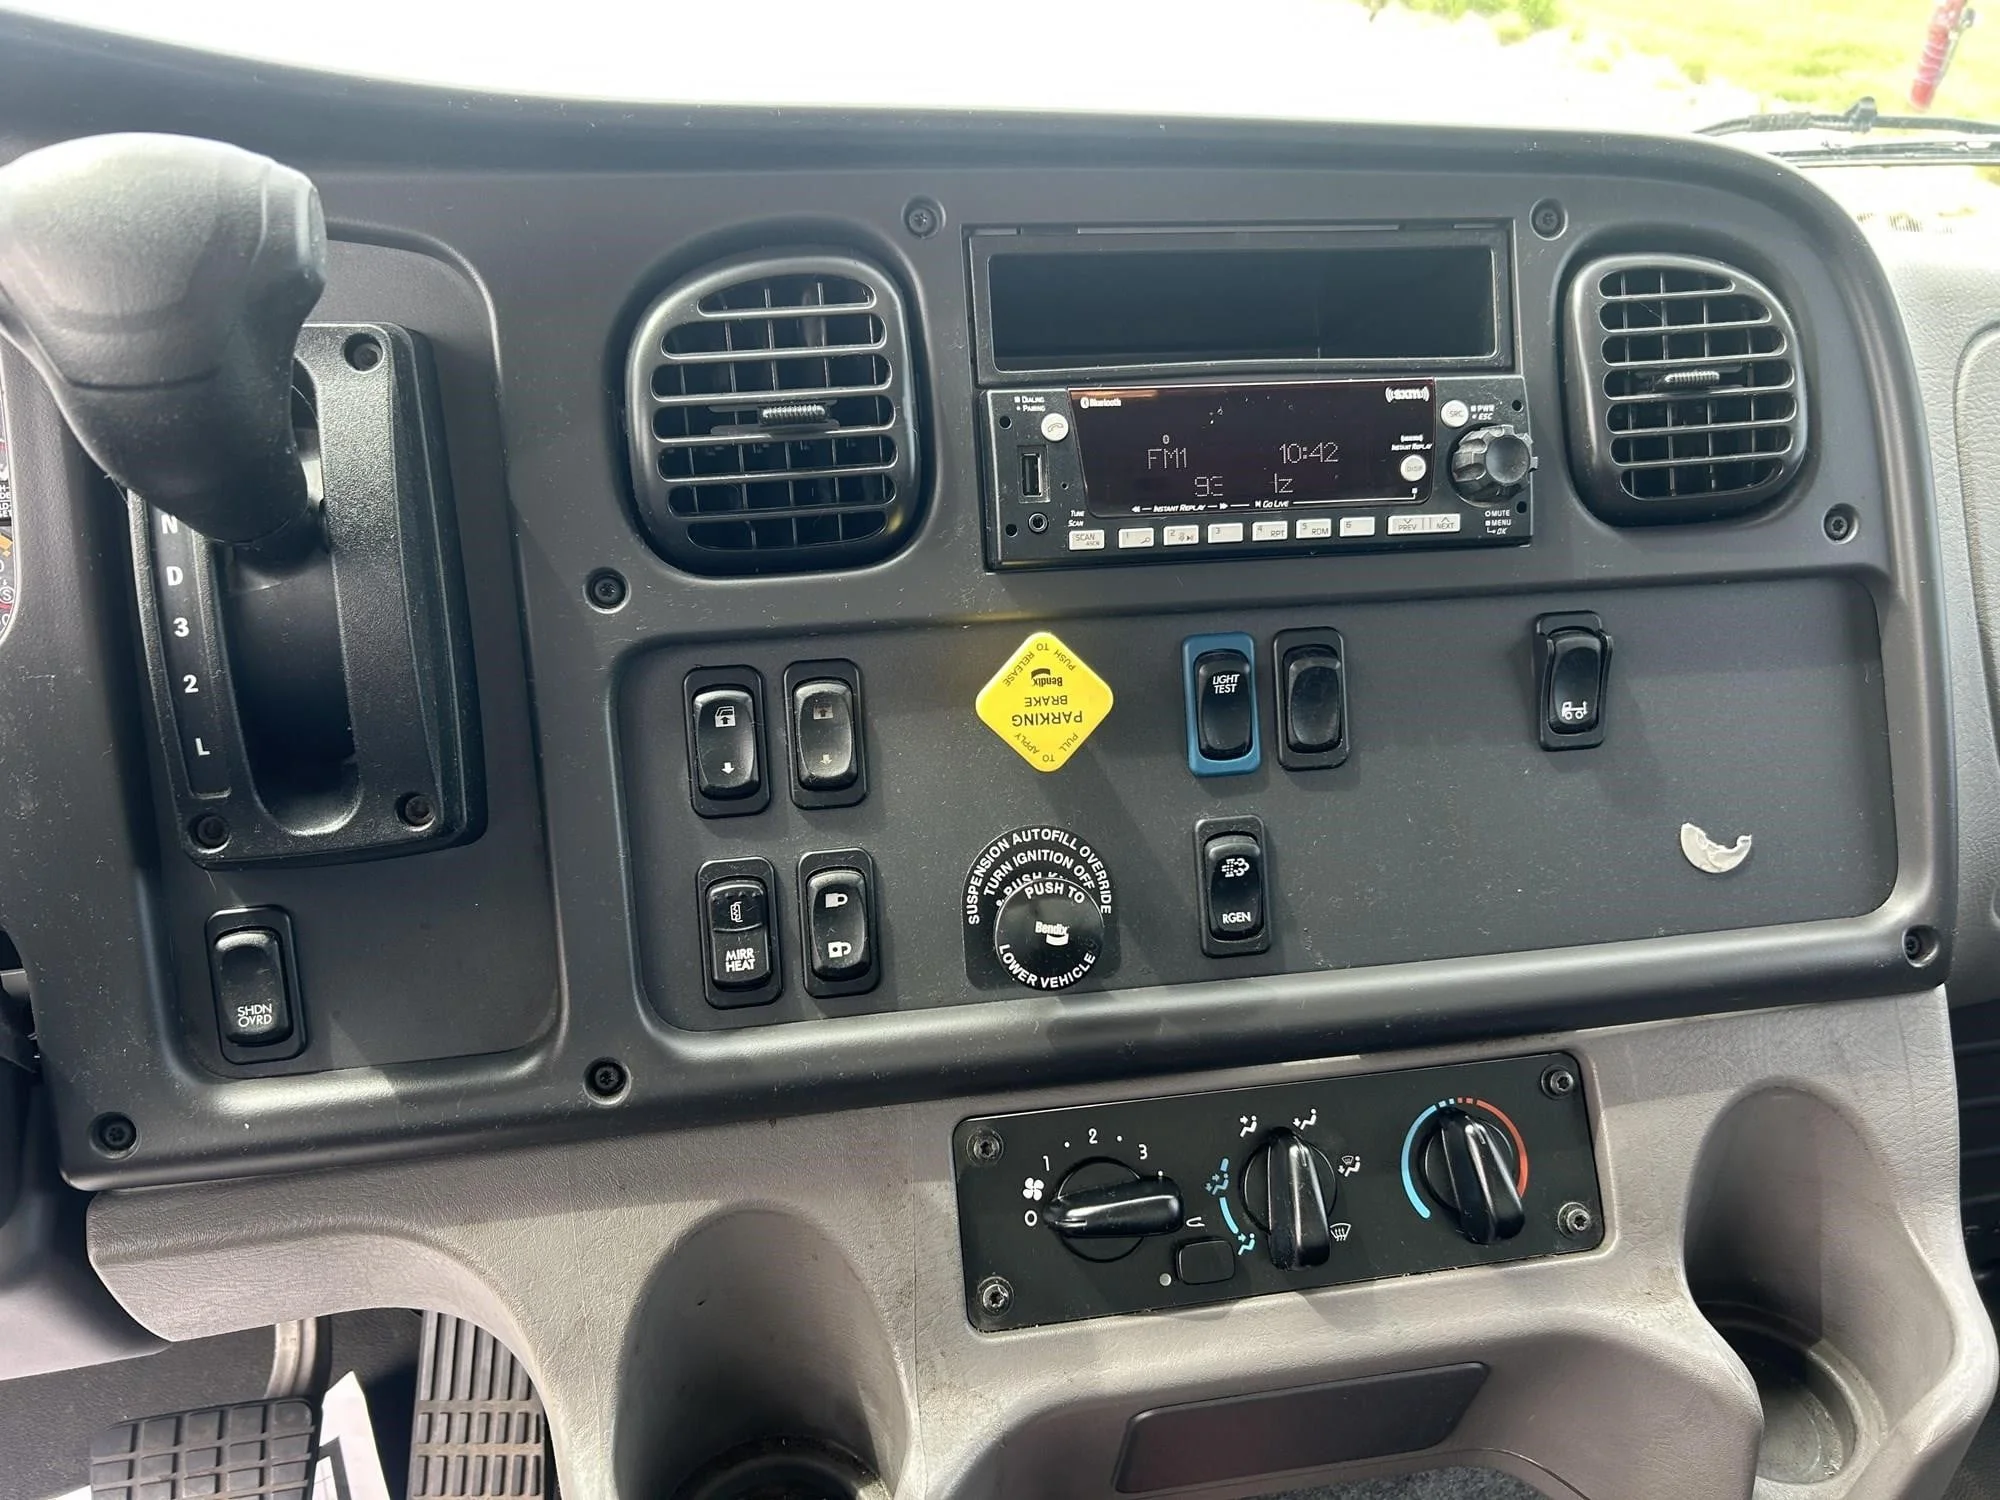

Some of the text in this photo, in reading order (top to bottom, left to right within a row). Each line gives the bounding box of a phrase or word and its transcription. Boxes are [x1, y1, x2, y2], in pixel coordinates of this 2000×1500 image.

[1448, 410, 1464, 418] SRC
[1477, 404, 1494, 412] PWR
[1478, 412, 1494, 420] ESC
[1147, 447, 1187, 469] FM1
[1279, 442, 1339, 464] 10:42
[161, 514, 178, 534] N
[1496, 527, 1508, 535] OK
[1075, 533, 1096, 541] SCAN
[166, 566, 184, 586] D
[173, 617, 190, 637] 3
[1002, 642, 1077, 687] PUSH TO RELEASE
[183, 674, 198, 694] 2
[1033, 676, 1063, 687] Bendix
[1212, 674, 1240, 685] LIGHT
[1214, 683, 1237, 694] TEST
[1024, 695, 1068, 707] BRAKE
[1012, 710, 1083, 727] PARKING
[195, 738, 210, 756] L
[1014, 732, 1079, 762] PULL TO APPLY
[966, 828, 1112, 925] SUSPENSION AUTOFILL OVERRIDE
[983, 849, 1096, 896] TURN IGNITION OFF
[1024, 882, 1085, 904] PUSH TO
[1222, 912, 1251, 924] RGEN
[1035, 921, 1068, 935] Bendix
[726, 948, 755, 961] MIRR
[725, 958, 756, 973] HEAT
[999, 944, 1096, 988] LOWER VEHICLE
[238, 1003, 272, 1016] SHDN
[238, 1014, 272, 1027] OVRD
[1088, 1128, 1098, 1144] 2
[1138, 1144, 1148, 1160] 3
[1042, 1155, 1050, 1172] 1
[1024, 1210, 1037, 1227] 0
